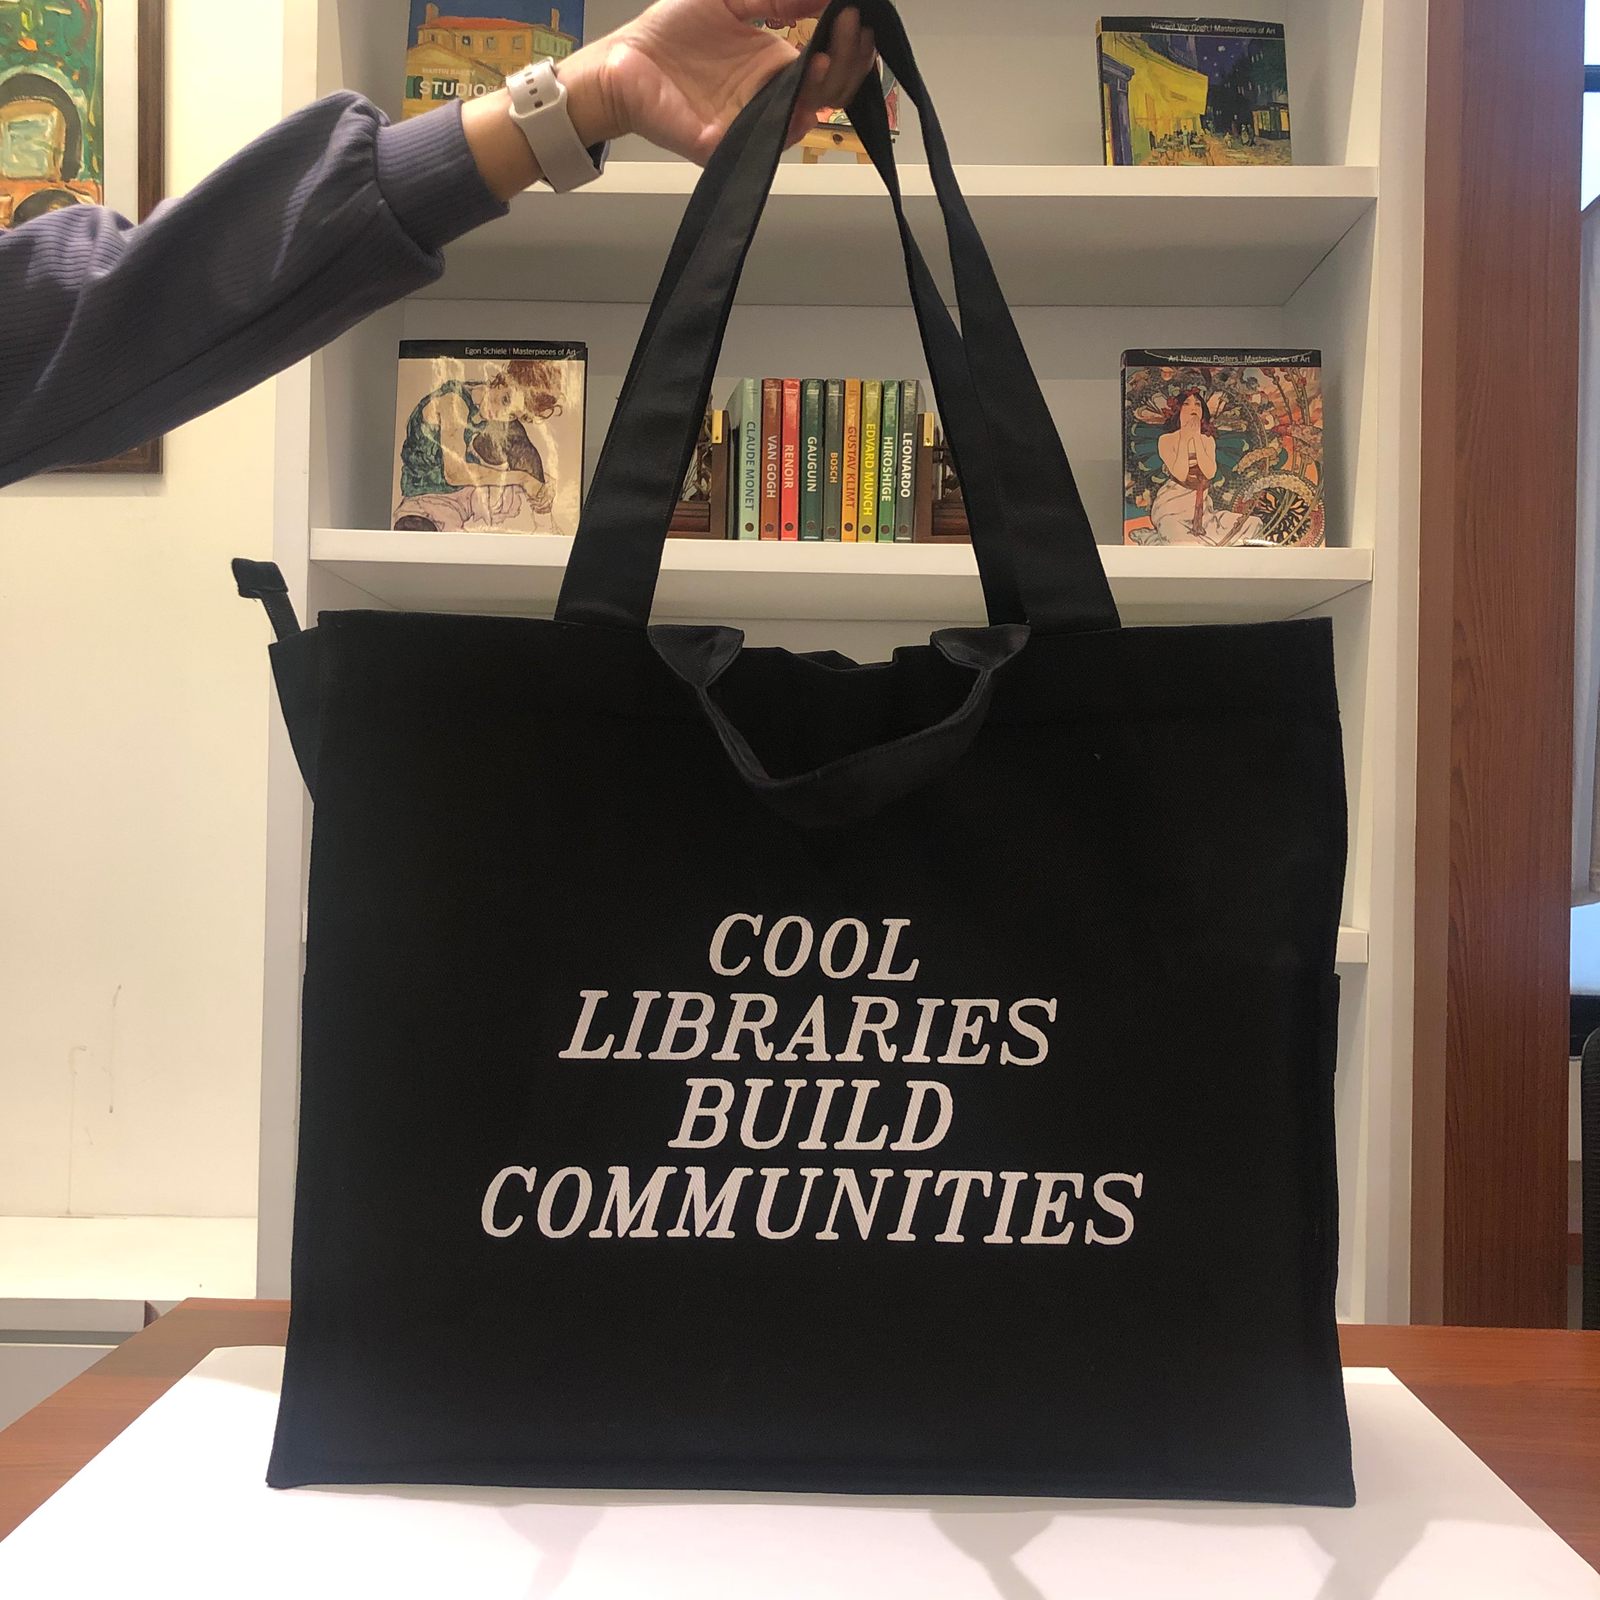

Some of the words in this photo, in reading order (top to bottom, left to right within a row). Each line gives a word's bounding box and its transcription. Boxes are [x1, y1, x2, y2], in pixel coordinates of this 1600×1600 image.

[1214, 26, 1257, 34] Masterpieces
[419, 81, 486, 97] STUDIO
[465, 347, 482, 355] Egon
[483, 347, 507, 355] Schiele
[513, 347, 557, 356] Masterpieces
[1213, 355, 1239, 363] Posters
[1244, 355, 1290, 364] Masterpieces
[1291, 355, 1298, 363] of
[1300, 355, 1311, 363] Art
[745, 421, 756, 466] CLAUDE
[767, 435, 778, 460] VAN
[806, 436, 818, 492] GAUGUIN
[846, 426, 858, 470] GUSTAV
[864, 423, 876, 469] EDVARD
[900, 432, 913, 498] LEONARDO
[766, 464, 777, 498] GOGH
[784, 444, 794, 489] RENOIR
[829, 452, 838, 484] BOSCH
[881, 436, 894, 502] HIROSHIGE
[744, 468, 755, 511] MONET
[845, 472, 857, 508] KLIMT
[863, 471, 875, 516] MUNCH
[708, 913, 920, 982] COOL
[558, 989, 1058, 1066] LIBRARIES
[667, 1077, 954, 1151] BUILD
[480, 1165, 1144, 1245] COMMUNITIES
